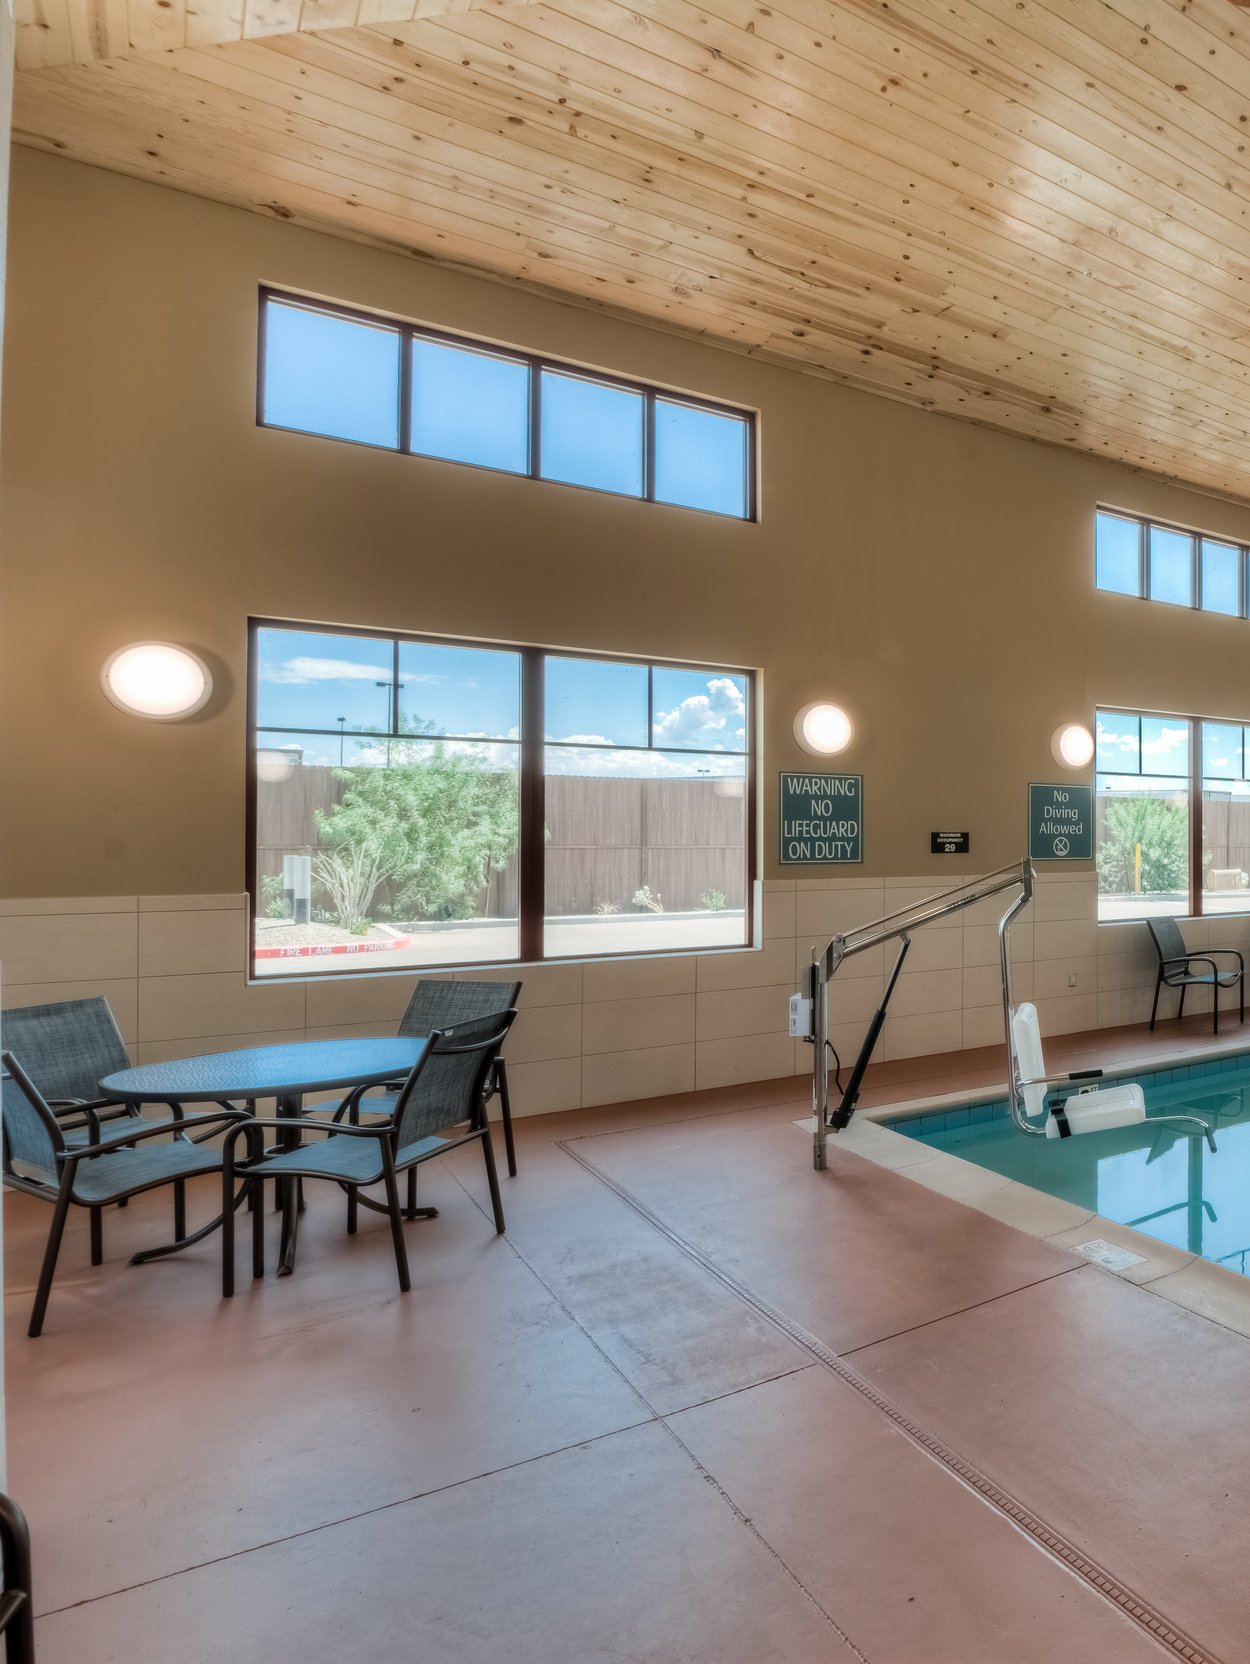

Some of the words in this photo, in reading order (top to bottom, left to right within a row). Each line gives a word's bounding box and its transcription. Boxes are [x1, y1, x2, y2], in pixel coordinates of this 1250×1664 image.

[788, 778, 855, 796] WARNING
[1054, 790, 1069, 802] No
[811, 800, 832, 816] NO
[1044, 806, 1078, 820] Diving
[784, 820, 857, 837] LIFEGUARD
[1039, 821, 1083, 834] Allowed
[789, 842, 810, 858] ON
[816, 842, 854, 858] DUTY
[944, 844, 956, 852] 29
[279, 947, 302, 957] FIRE
[308, 946, 334, 956] LANE
[363, 942, 396, 953] PARKING
